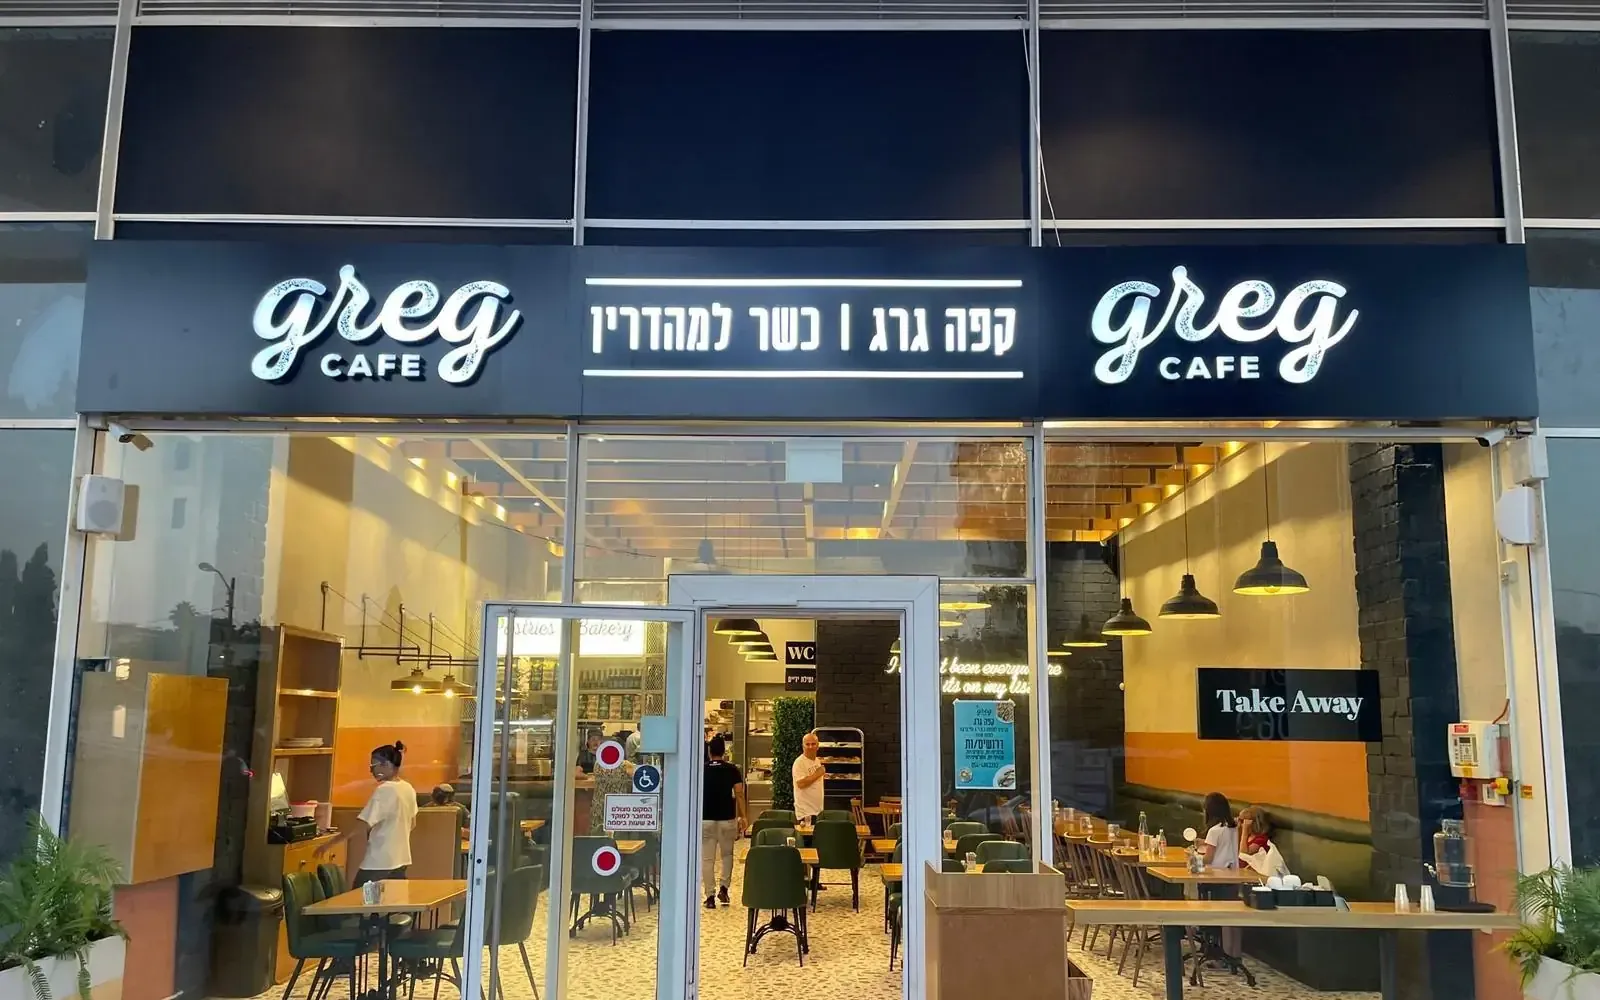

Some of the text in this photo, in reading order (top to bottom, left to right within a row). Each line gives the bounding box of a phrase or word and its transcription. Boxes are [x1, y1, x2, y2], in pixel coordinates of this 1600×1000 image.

[251, 264, 521, 384] greg
[590, 302, 732, 353] למהדרין
[748, 306, 820, 351] כשר
[869, 307, 930, 352] גרג
[945, 307, 1016, 356] קפה
[1091, 265, 1359, 384] greg
[320, 353, 421, 378] CAFE
[1159, 356, 1260, 380] CAFE
[787, 646, 815, 660] WC
[949, 656, 981, 674] been
[963, 681, 981, 693] on
[983, 681, 1007, 699] my
[1008, 674, 1031, 693] lis
[1216, 688, 1364, 721] Take Away
